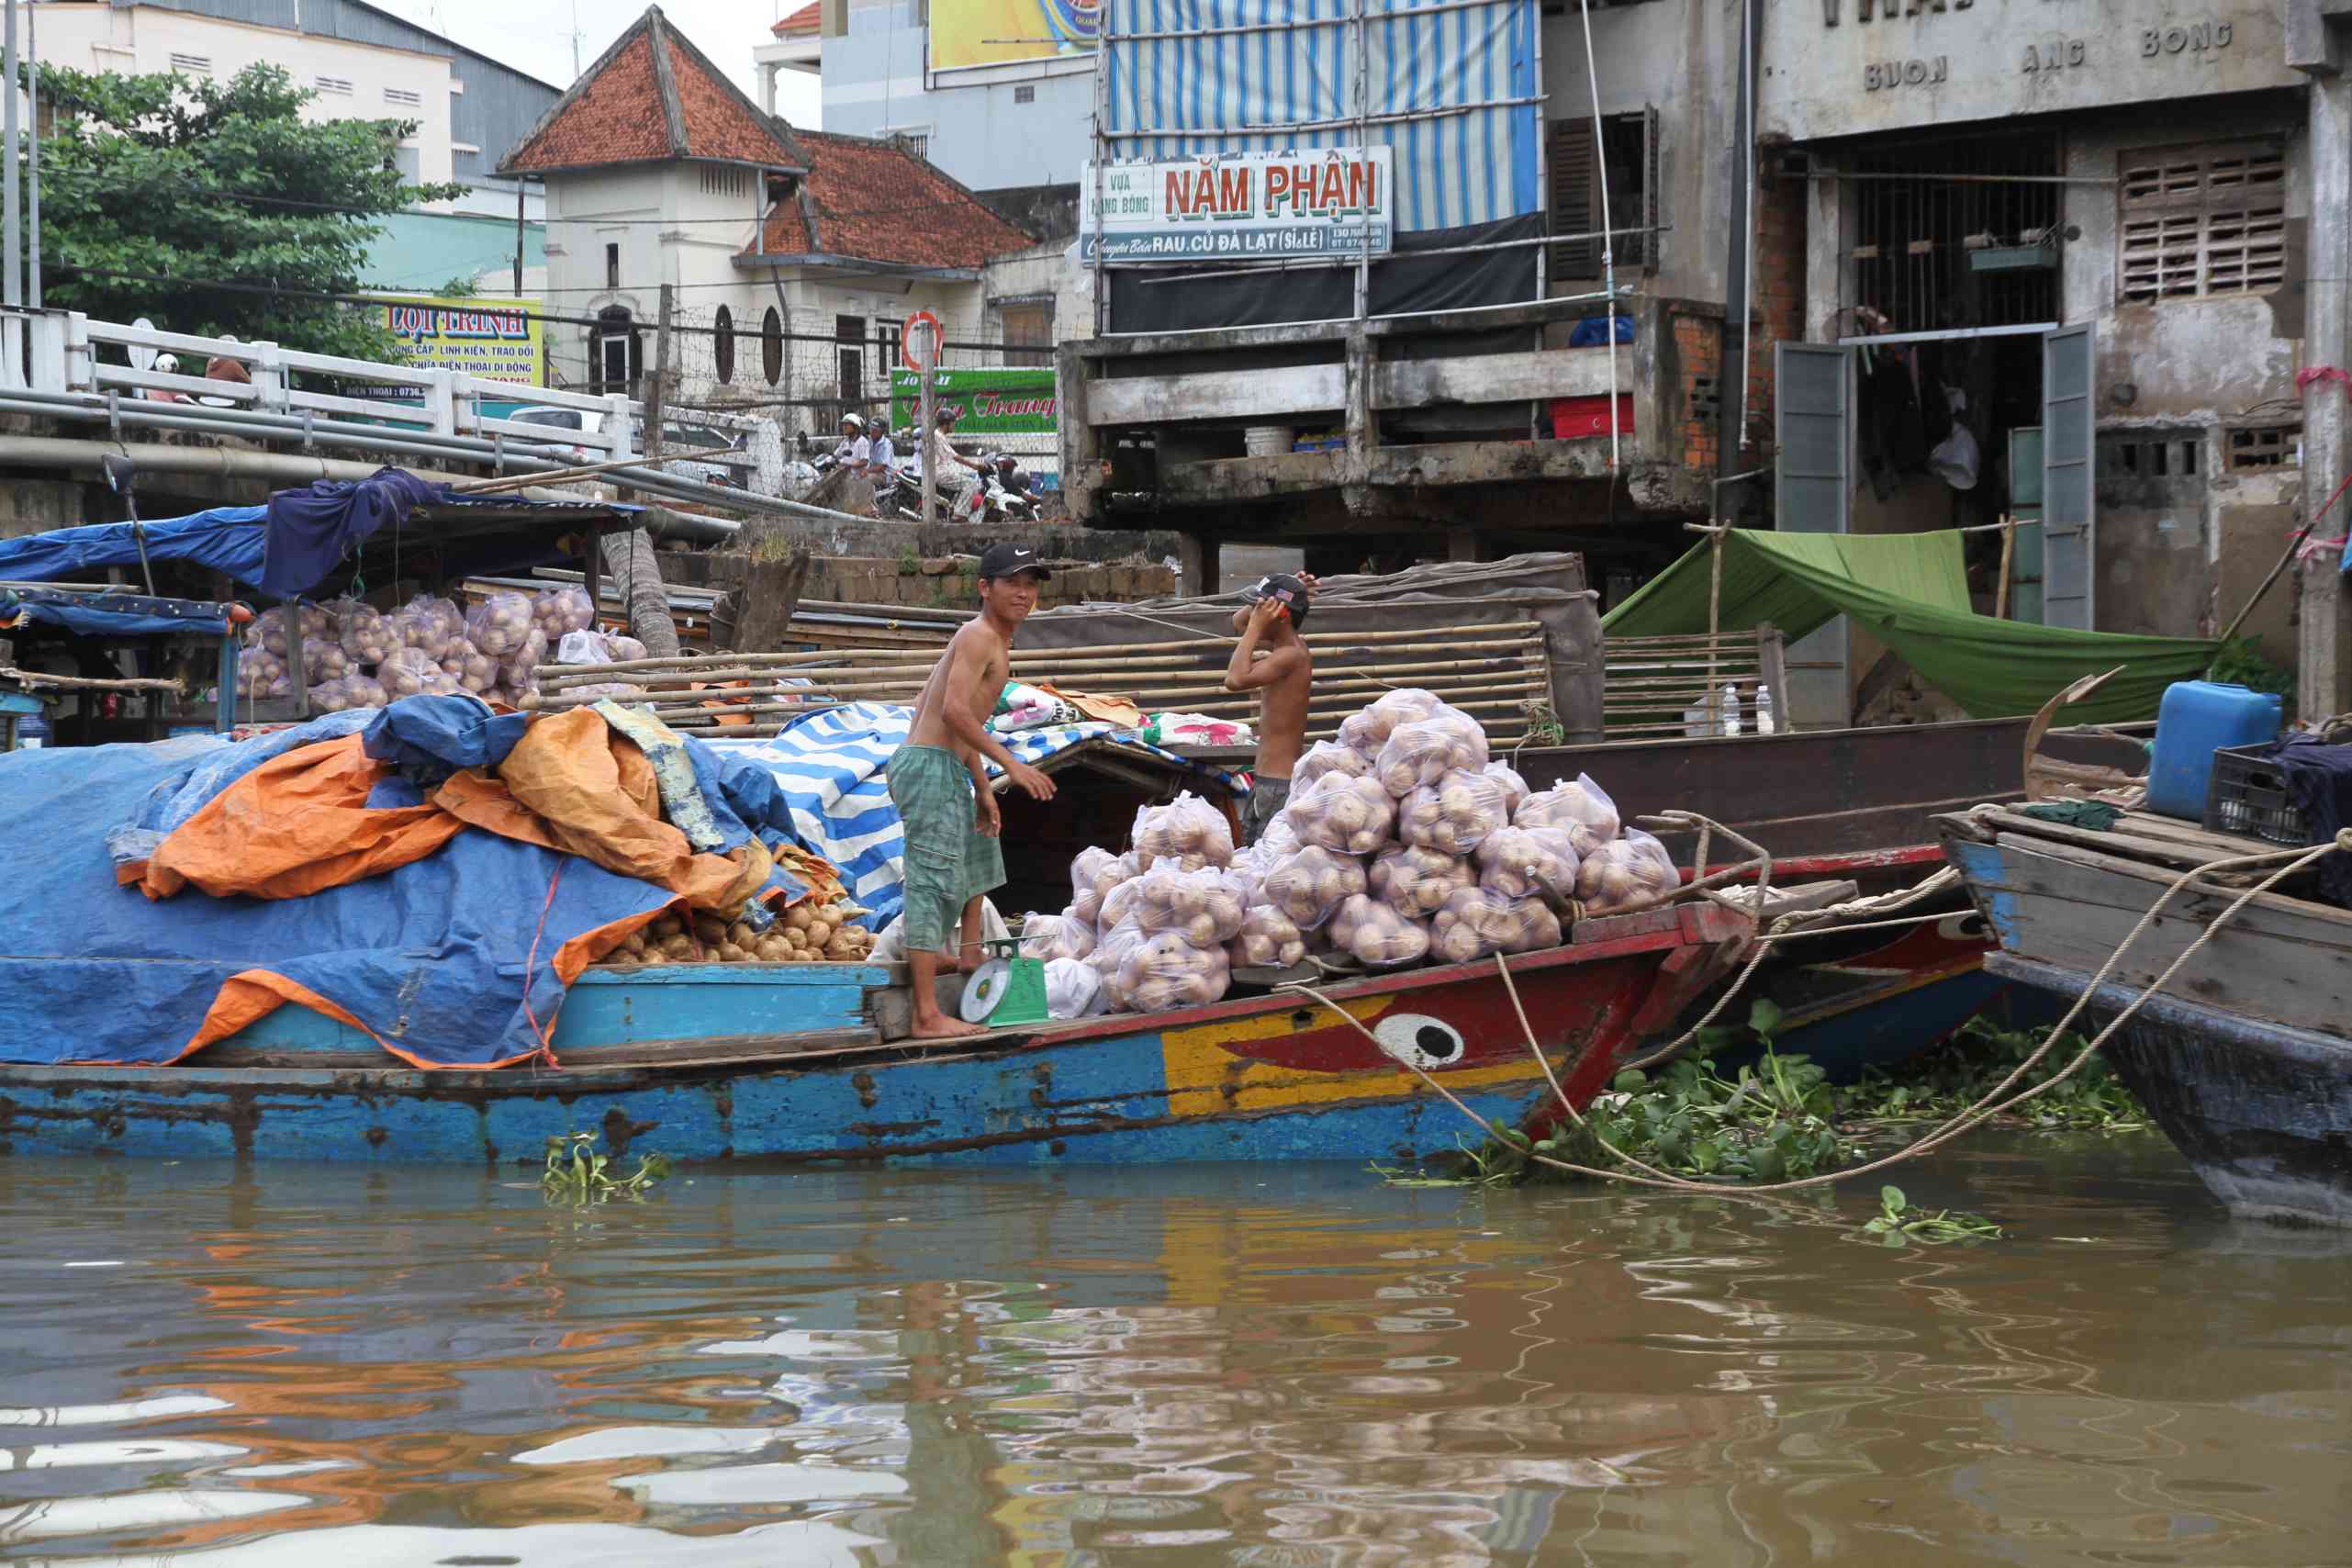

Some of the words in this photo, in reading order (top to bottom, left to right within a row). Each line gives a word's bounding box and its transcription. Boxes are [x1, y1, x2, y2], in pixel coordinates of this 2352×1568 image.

[1166, 158, 1251, 218] NĂM
[1265, 150, 1378, 220] PHẬN
[1218, 230, 1240, 252] ĐÀ
[1246, 232, 1277, 252] LẠT
[440, 308, 530, 340] TRINH
[441, 344, 461, 355] LINH
[492, 346, 514, 356] TRAO
